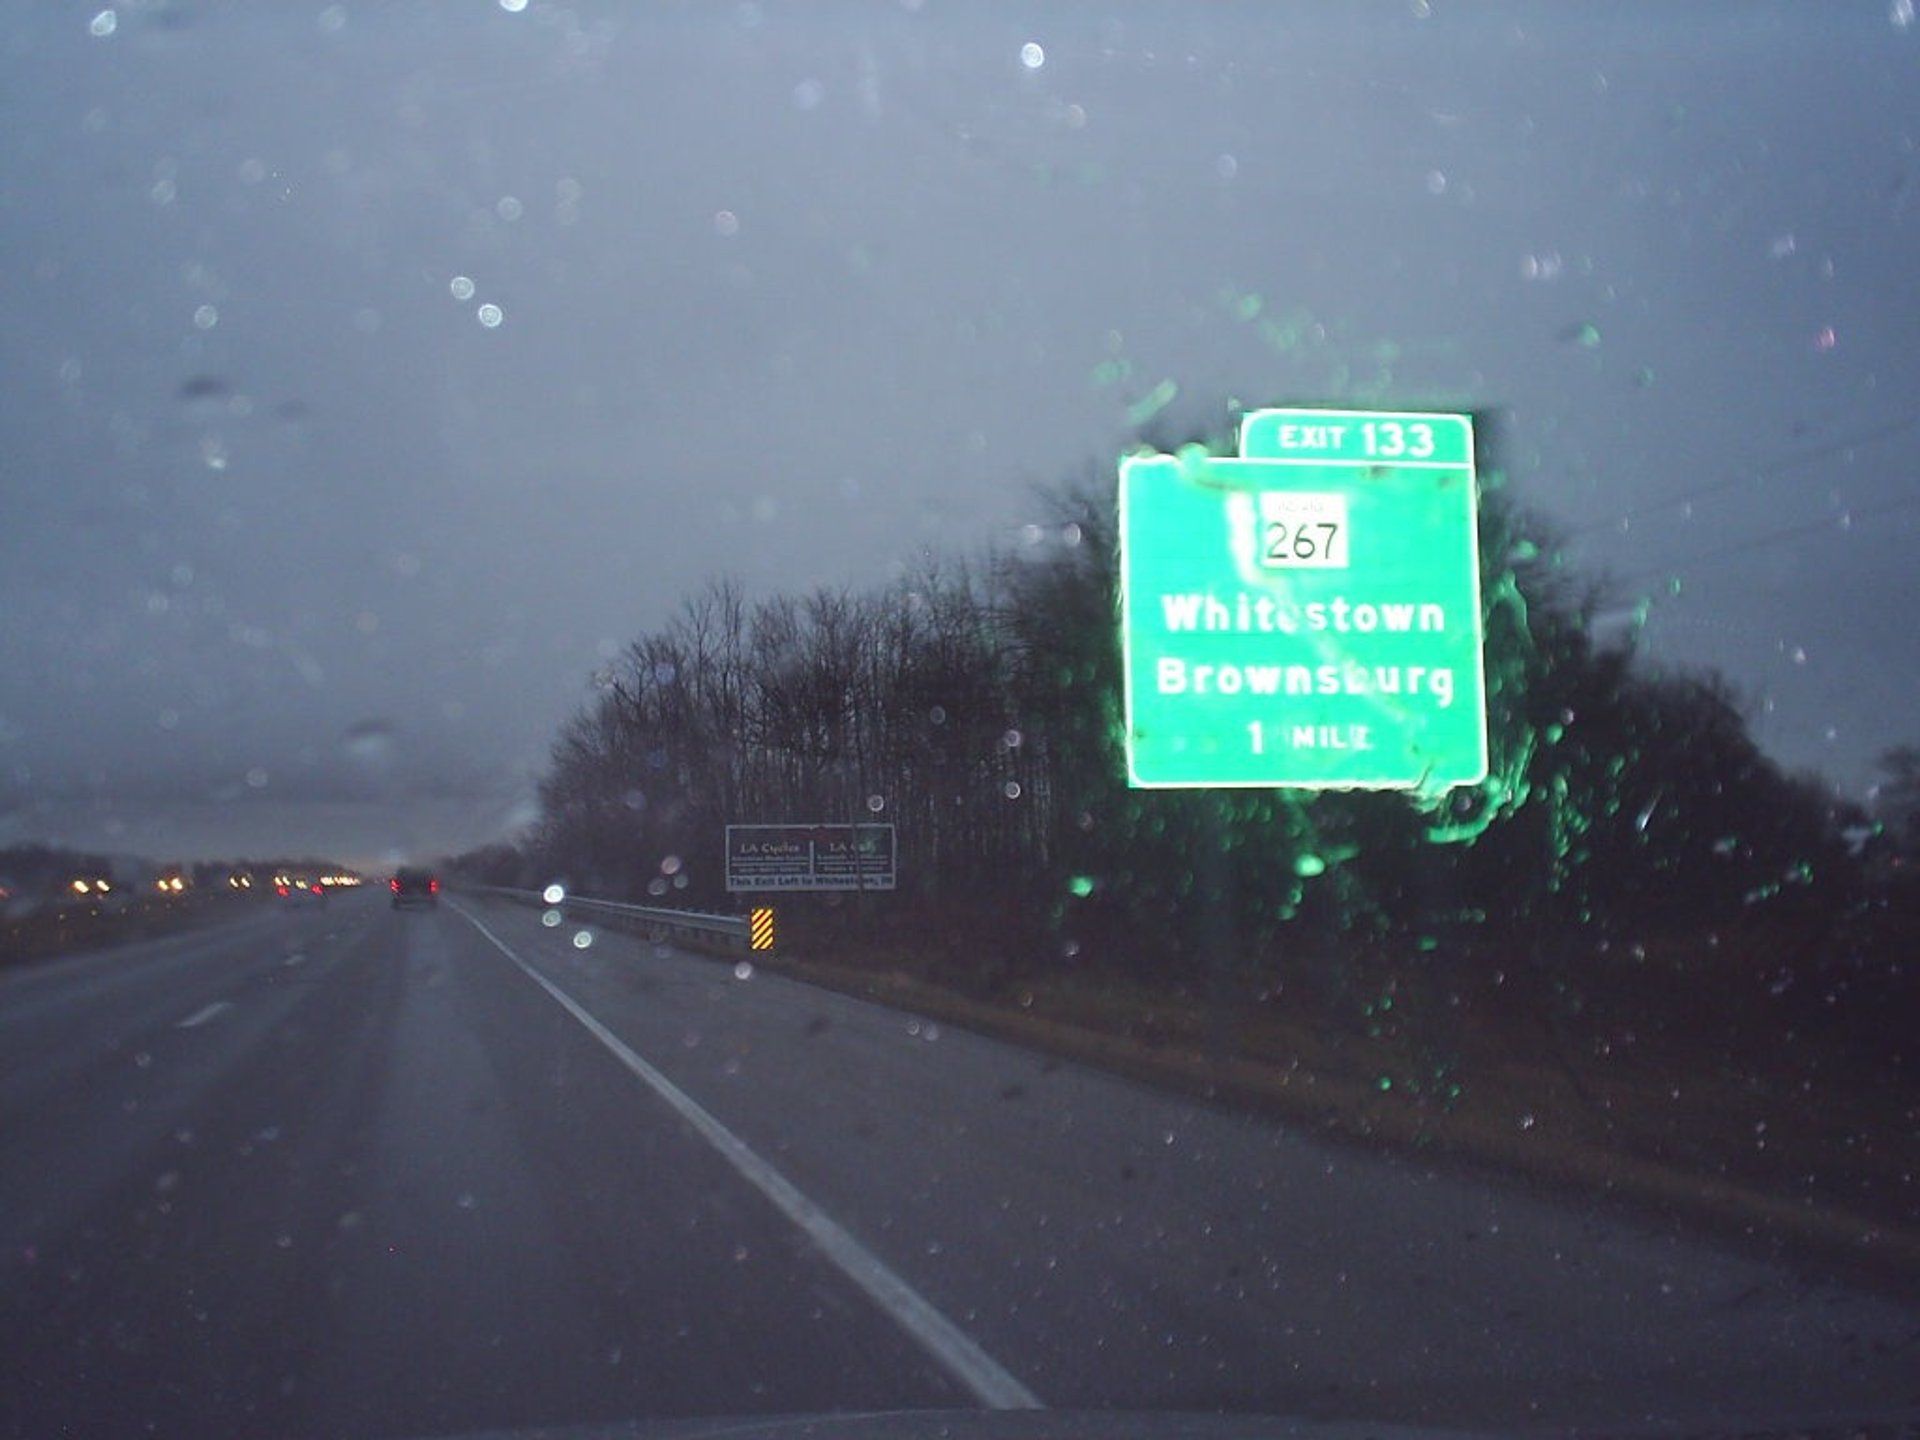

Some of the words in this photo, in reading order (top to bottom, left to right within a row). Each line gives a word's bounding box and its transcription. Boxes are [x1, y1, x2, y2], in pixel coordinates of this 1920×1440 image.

[1278, 425, 1346, 449] EXIT
[1362, 423, 1434, 457] 133
[1266, 522, 1338, 559] 267
[1247, 721, 1264, 754] 1
